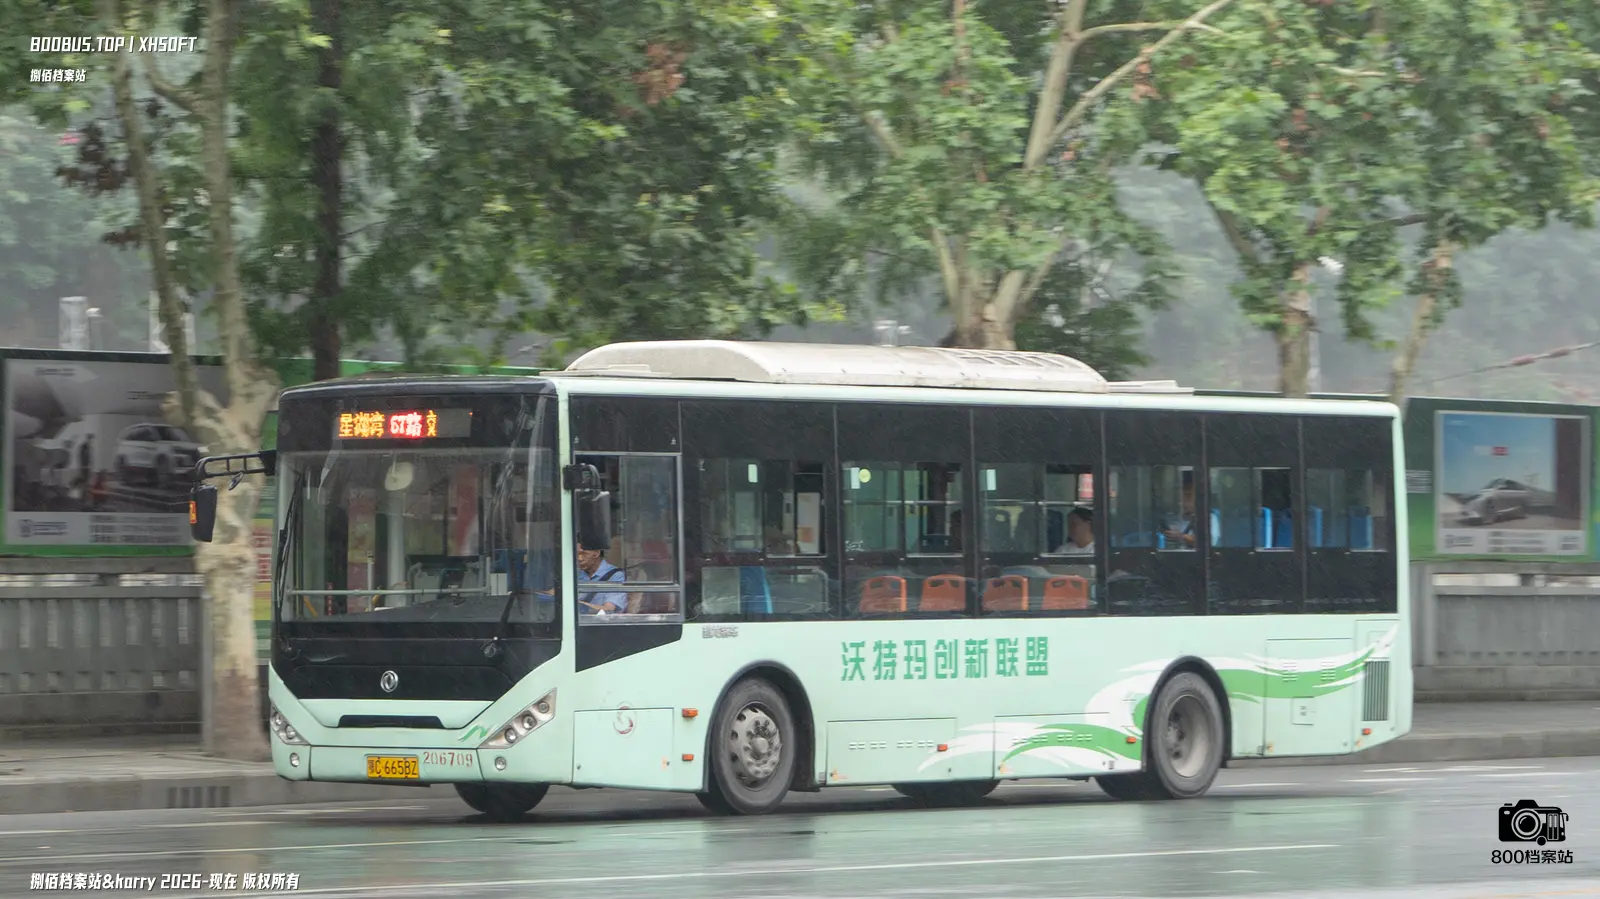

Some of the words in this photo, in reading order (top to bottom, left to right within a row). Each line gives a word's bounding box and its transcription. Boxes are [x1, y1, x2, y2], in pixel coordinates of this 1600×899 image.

[841, 636, 1049, 681] 沃特玛创新联盟
[423, 751, 473, 768] 206709
